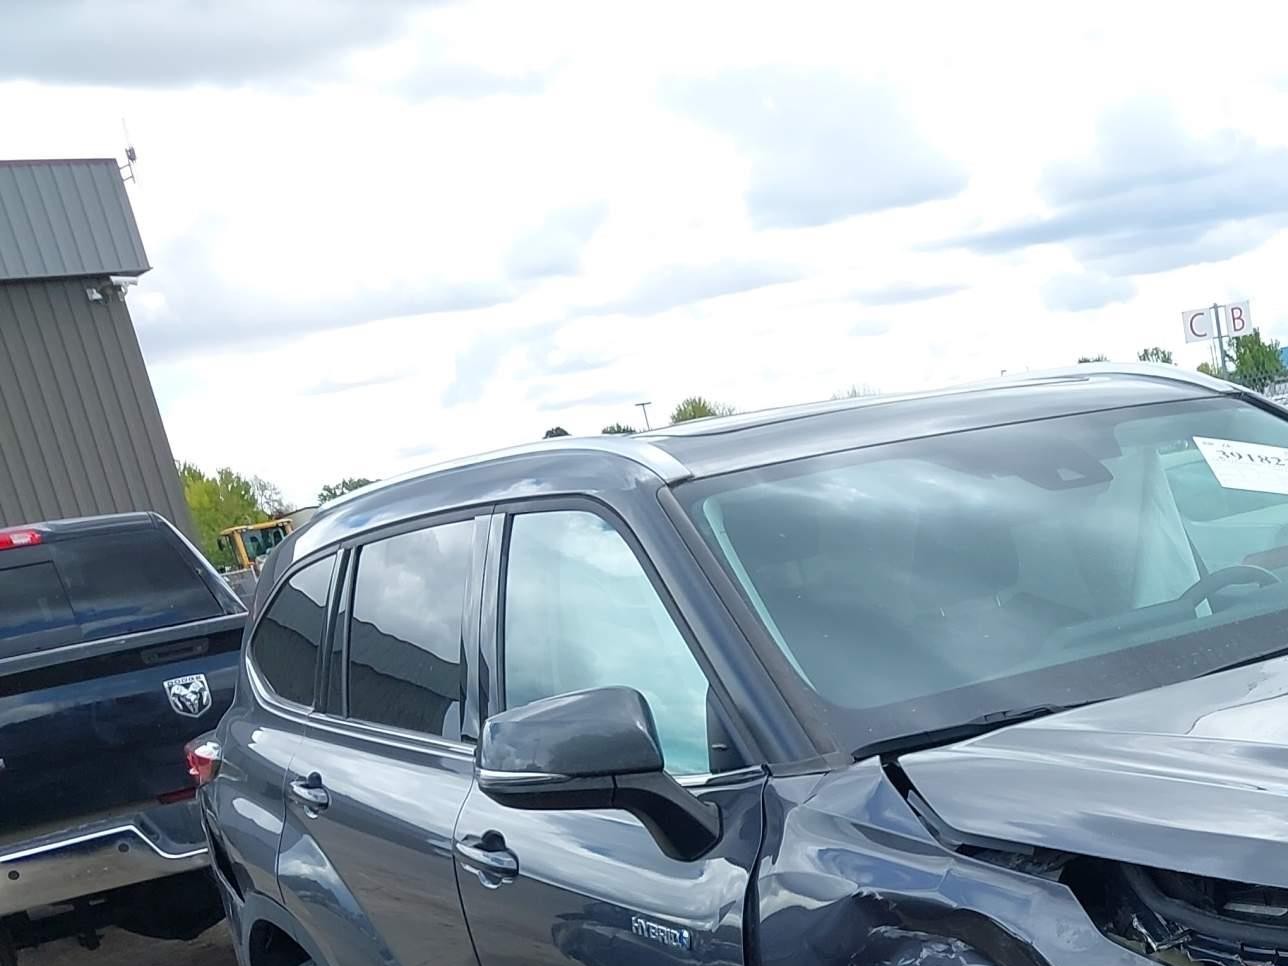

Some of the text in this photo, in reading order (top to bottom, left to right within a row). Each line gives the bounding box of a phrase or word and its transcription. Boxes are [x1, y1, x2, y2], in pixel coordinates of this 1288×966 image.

[1189, 312, 1208, 338] C
[1230, 307, 1246, 332] B
[631, 915, 682, 947] HYBRID
